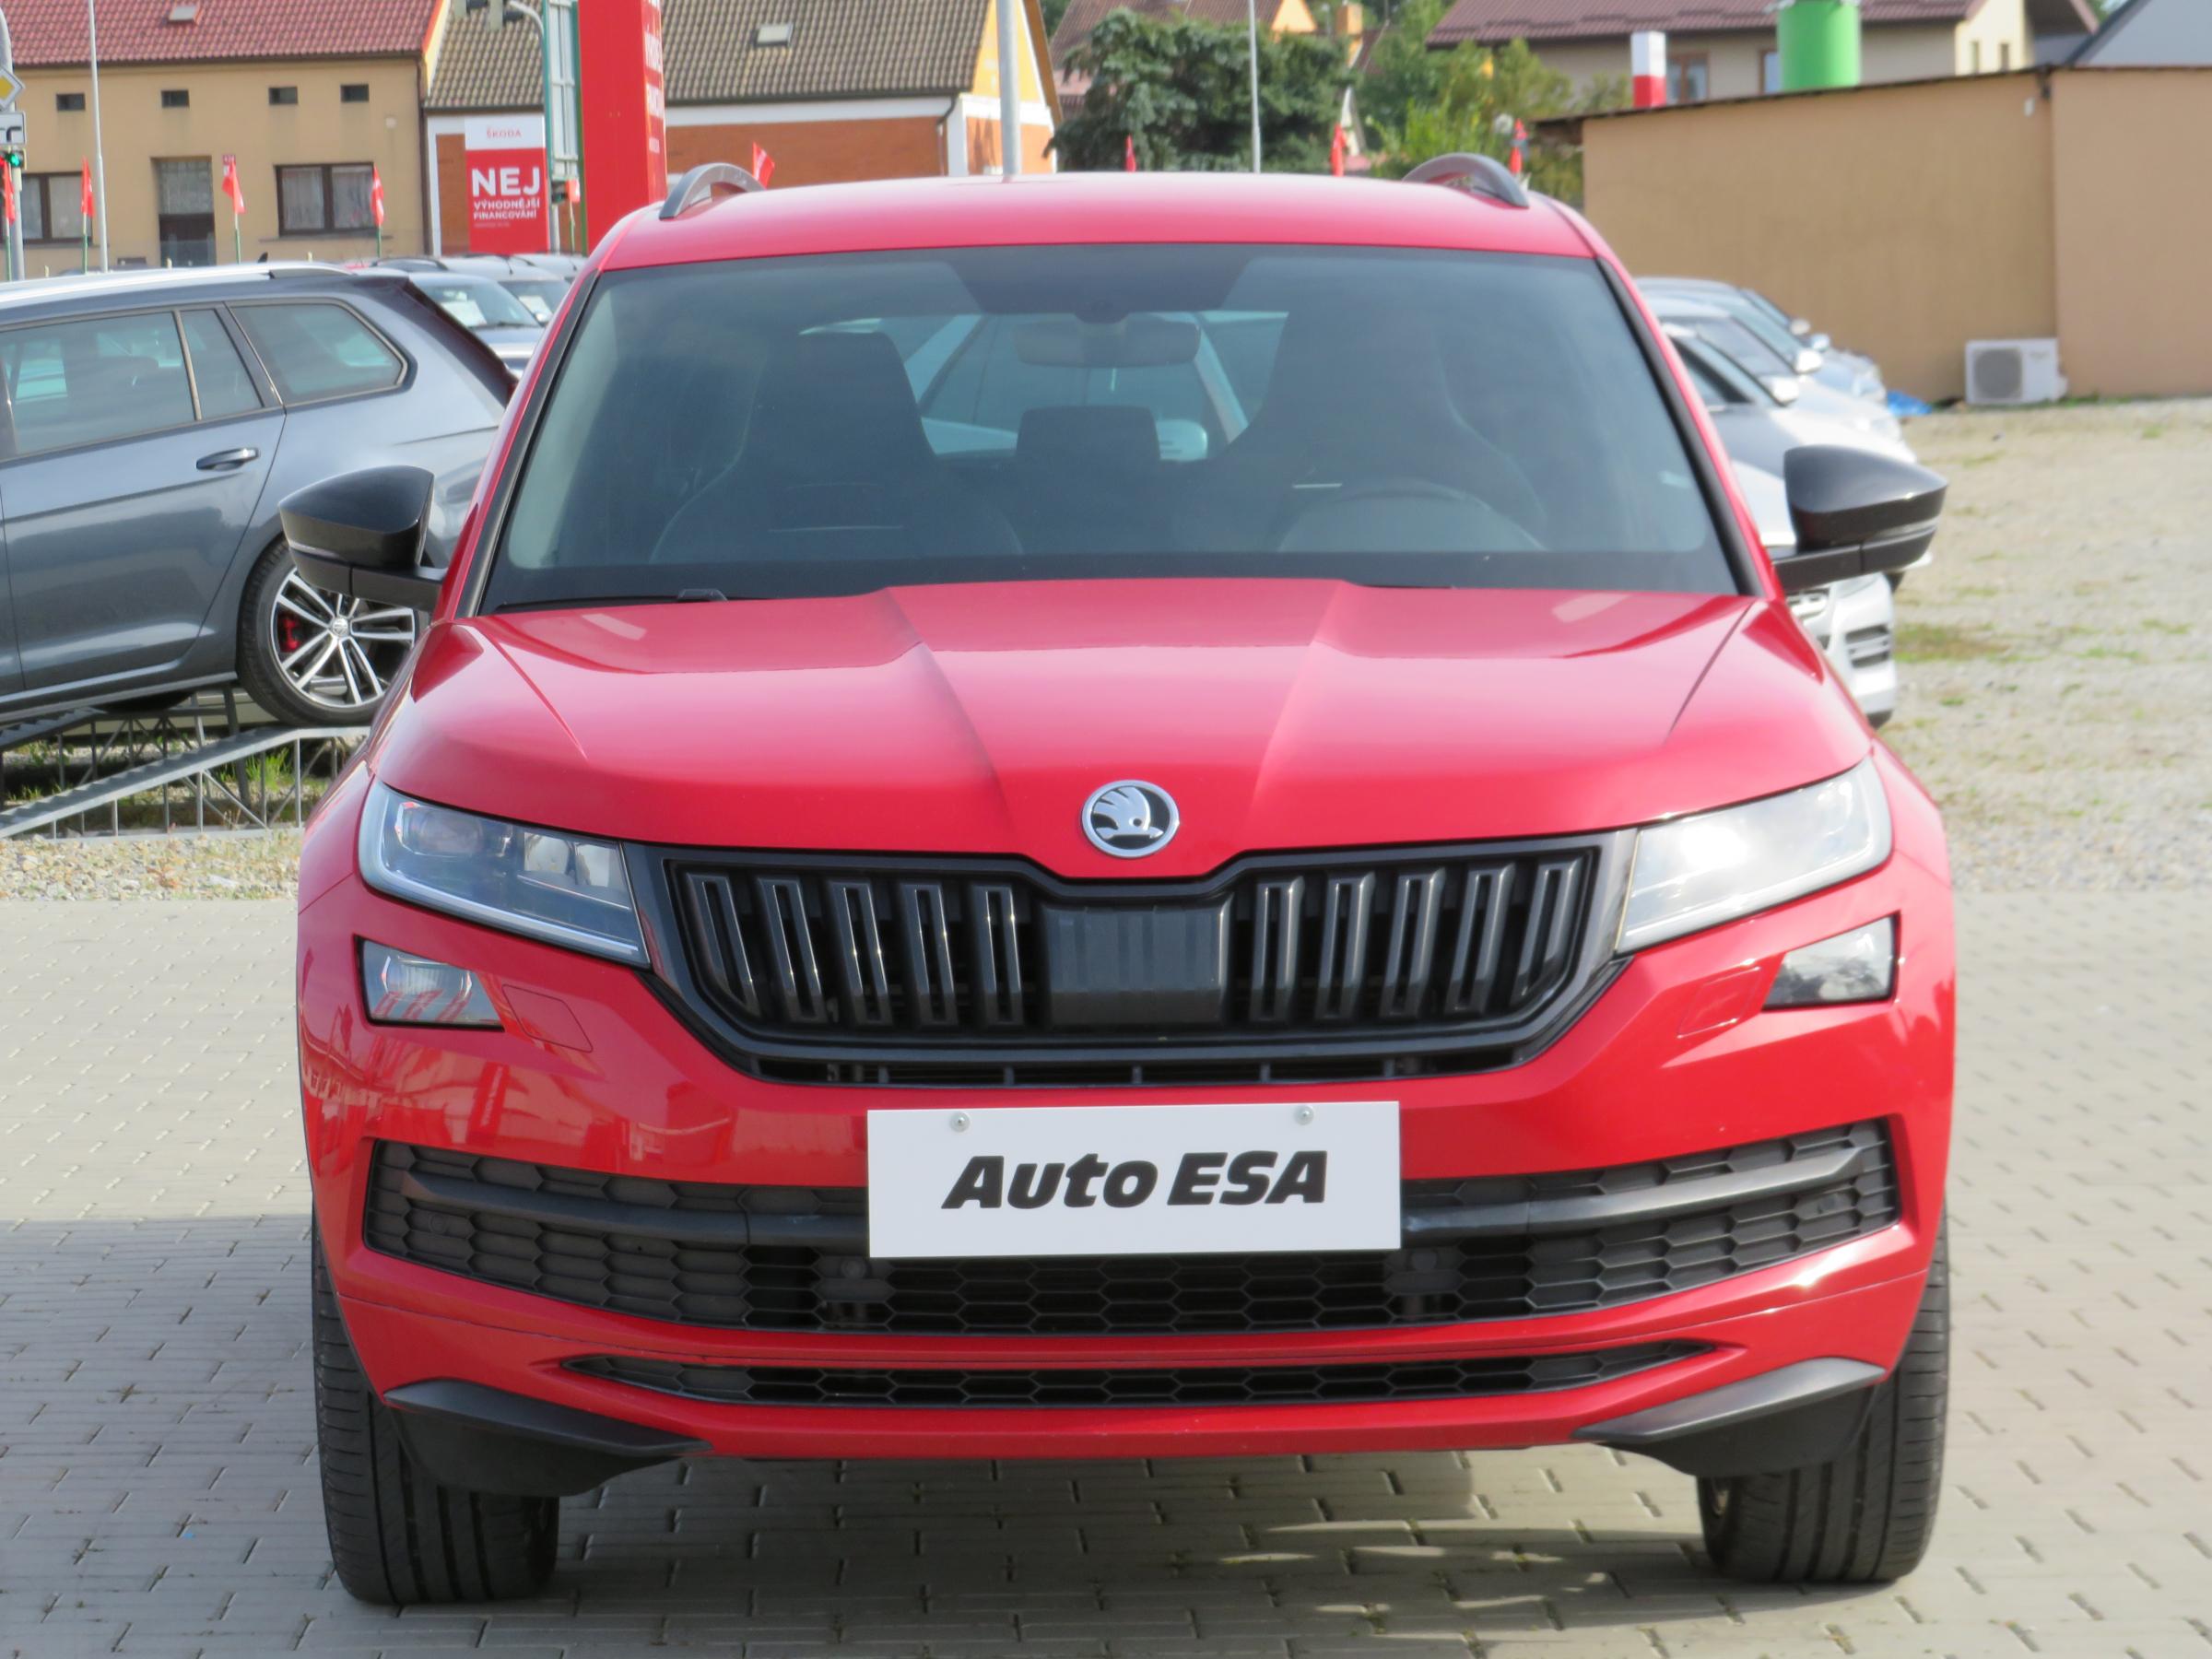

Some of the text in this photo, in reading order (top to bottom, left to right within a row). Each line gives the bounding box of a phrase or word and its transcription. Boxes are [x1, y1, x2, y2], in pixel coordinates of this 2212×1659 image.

[472, 167, 540, 196] NEJ
[941, 1150, 1328, 1209] Auto ESA
